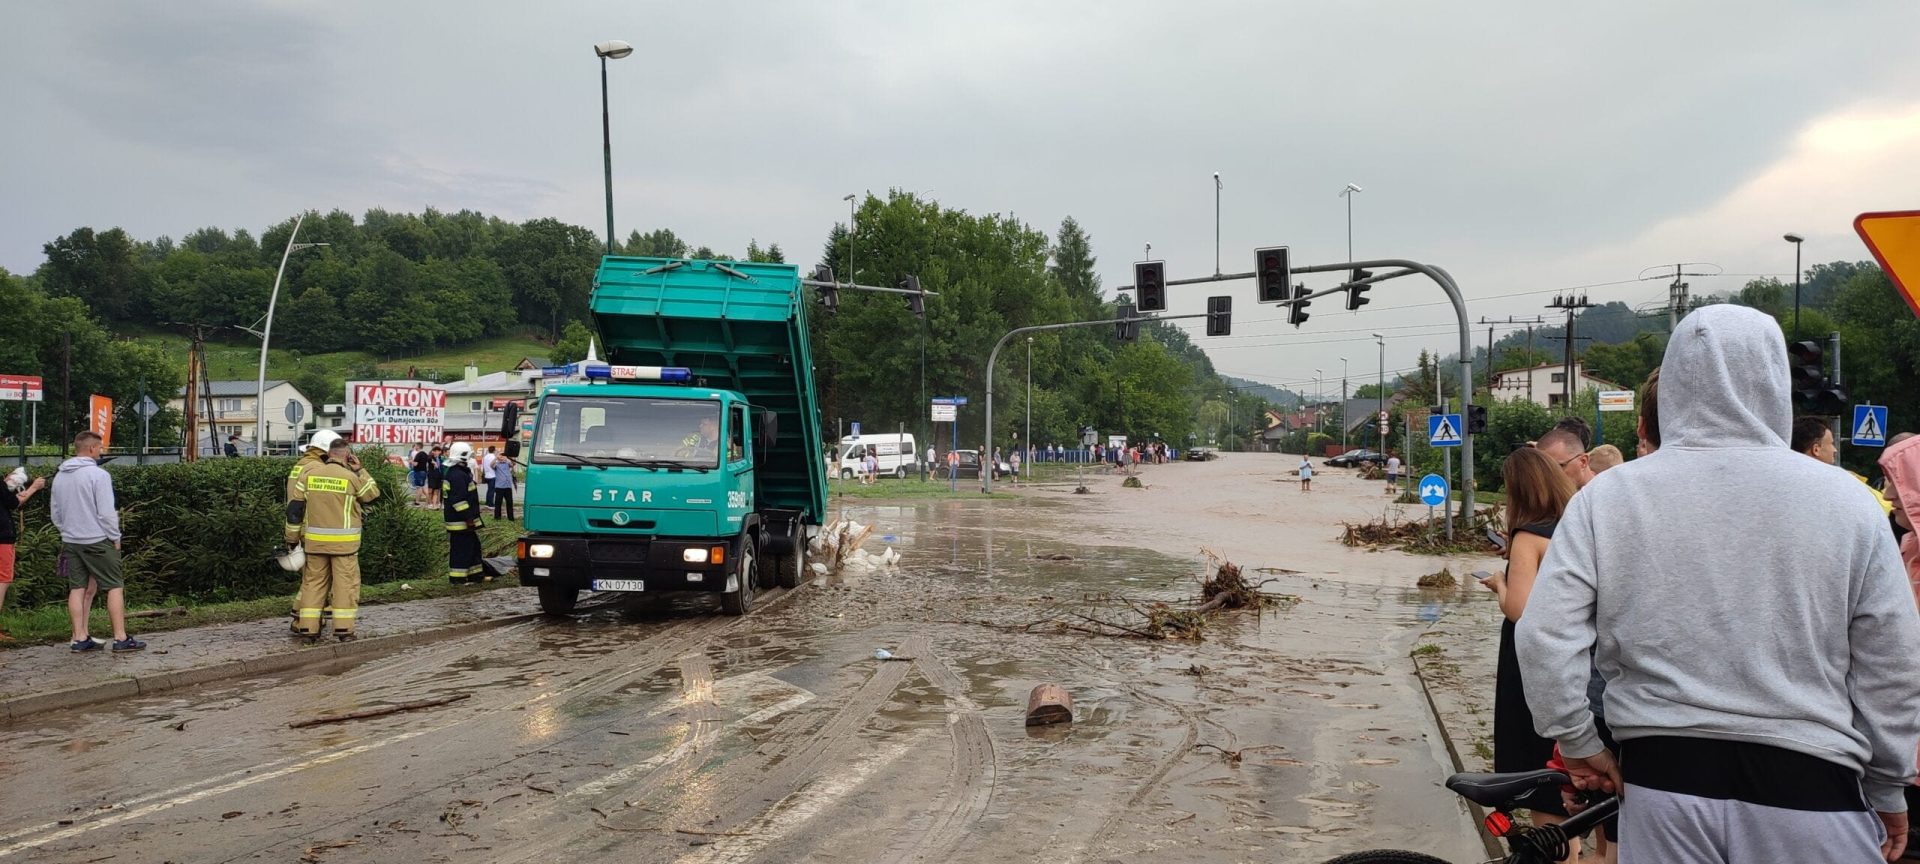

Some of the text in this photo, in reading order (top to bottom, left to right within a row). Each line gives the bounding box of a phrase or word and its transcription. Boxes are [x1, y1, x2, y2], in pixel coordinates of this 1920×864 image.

[358, 386, 444, 407] KARTONY
[377, 406, 438, 417] PartnerPak
[357, 425, 443, 443] FOLIE STRETCH
[592, 489, 652, 502] STAR
[598, 581, 643, 590] KN 07130
